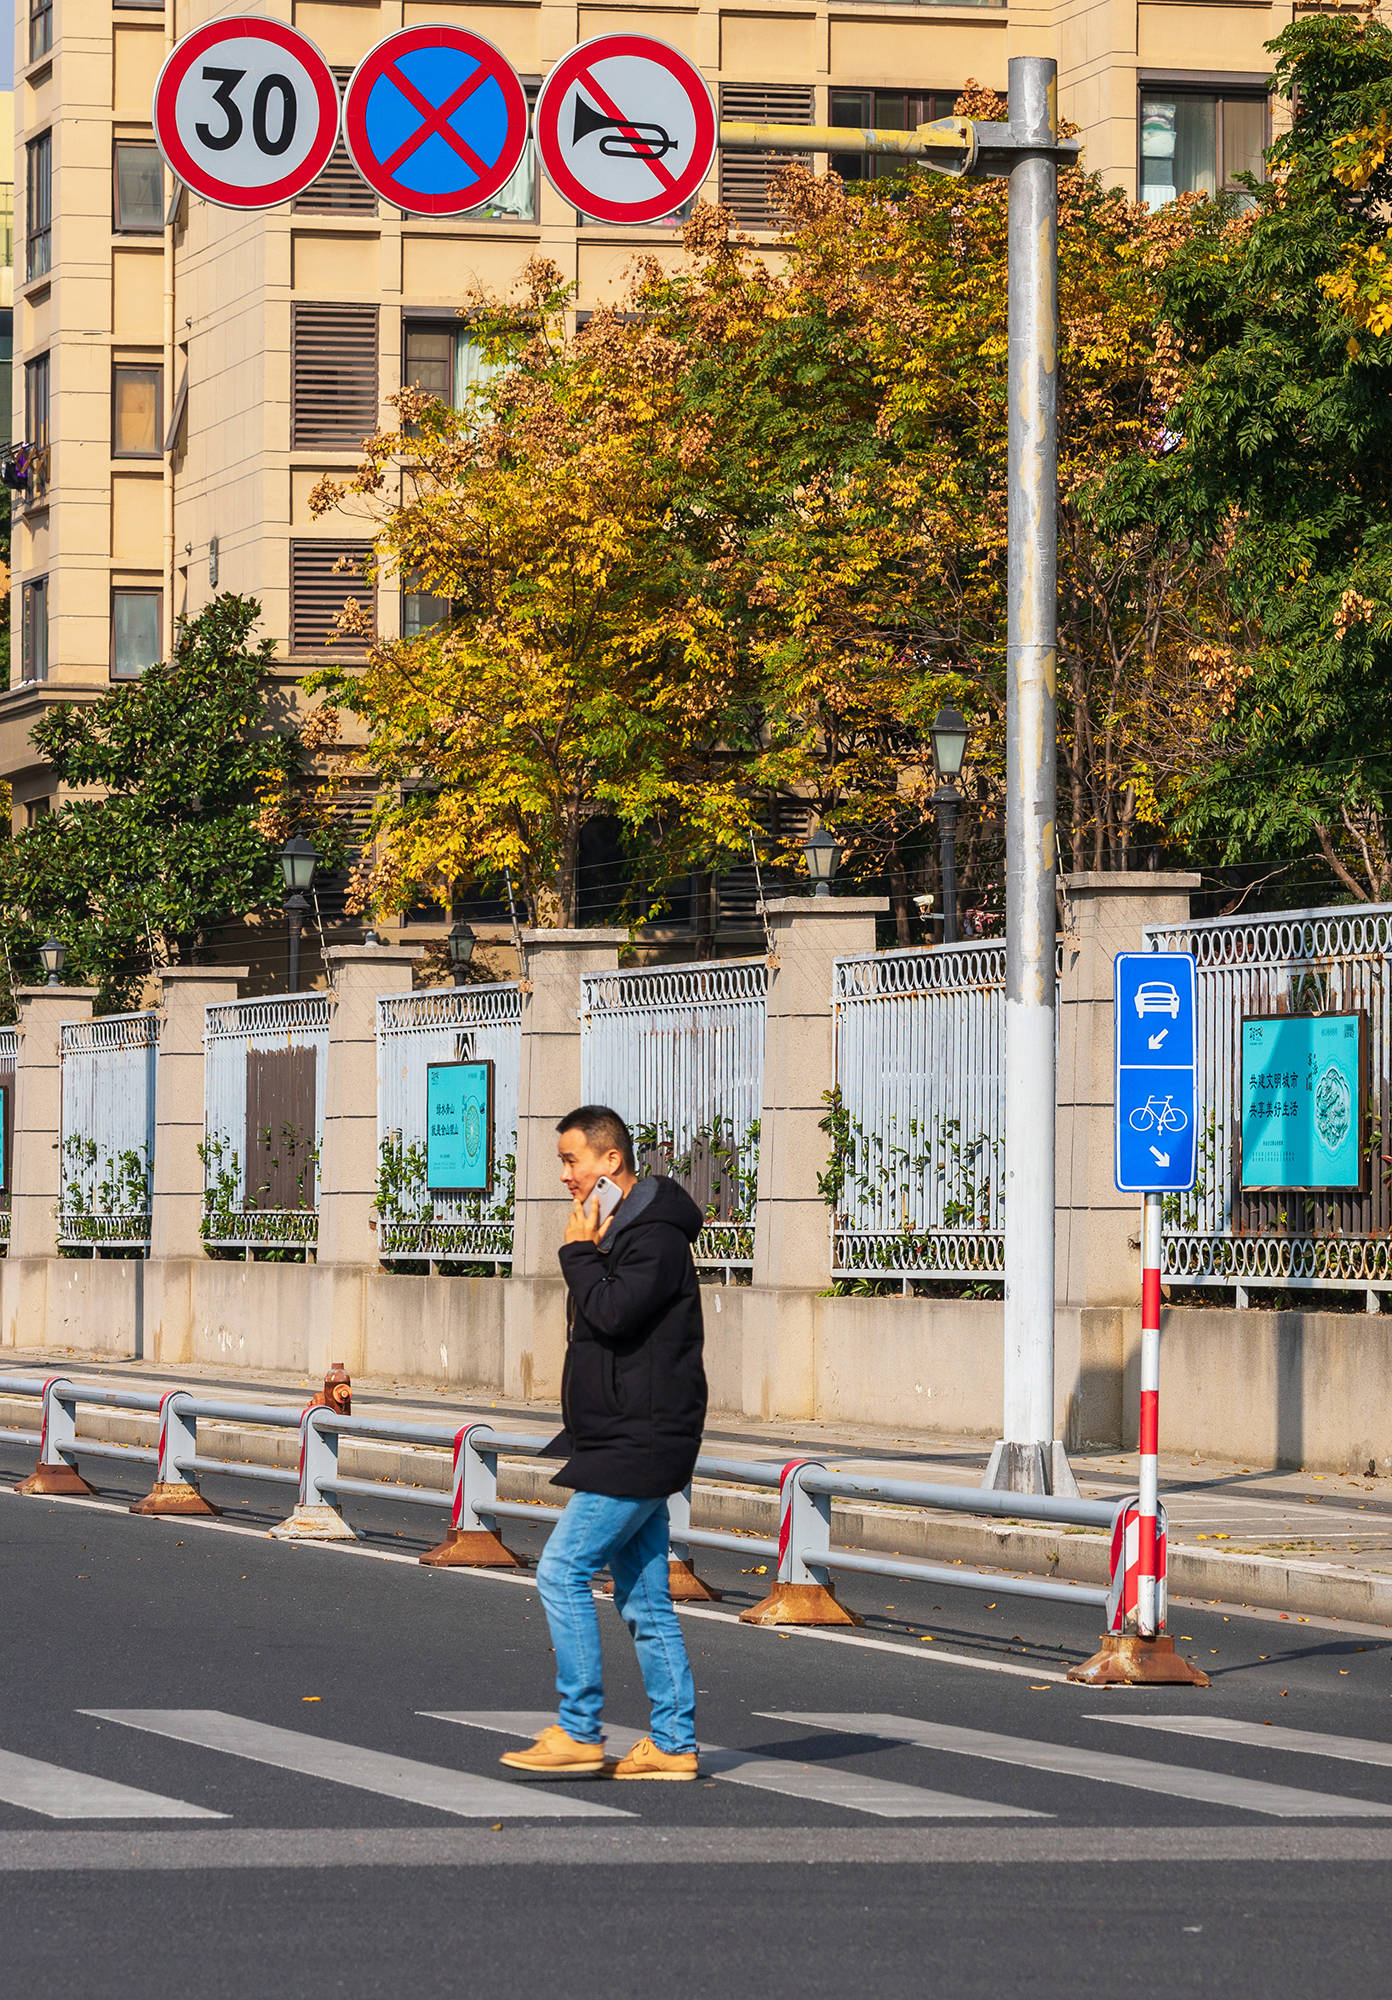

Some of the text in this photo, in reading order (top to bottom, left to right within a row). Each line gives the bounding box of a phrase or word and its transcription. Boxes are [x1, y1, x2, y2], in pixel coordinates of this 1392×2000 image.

[195, 66, 297, 156] 30
[1249, 1072, 1298, 1090] 共建文明城市
[1249, 1101, 1298, 1118] 共享美好生活
